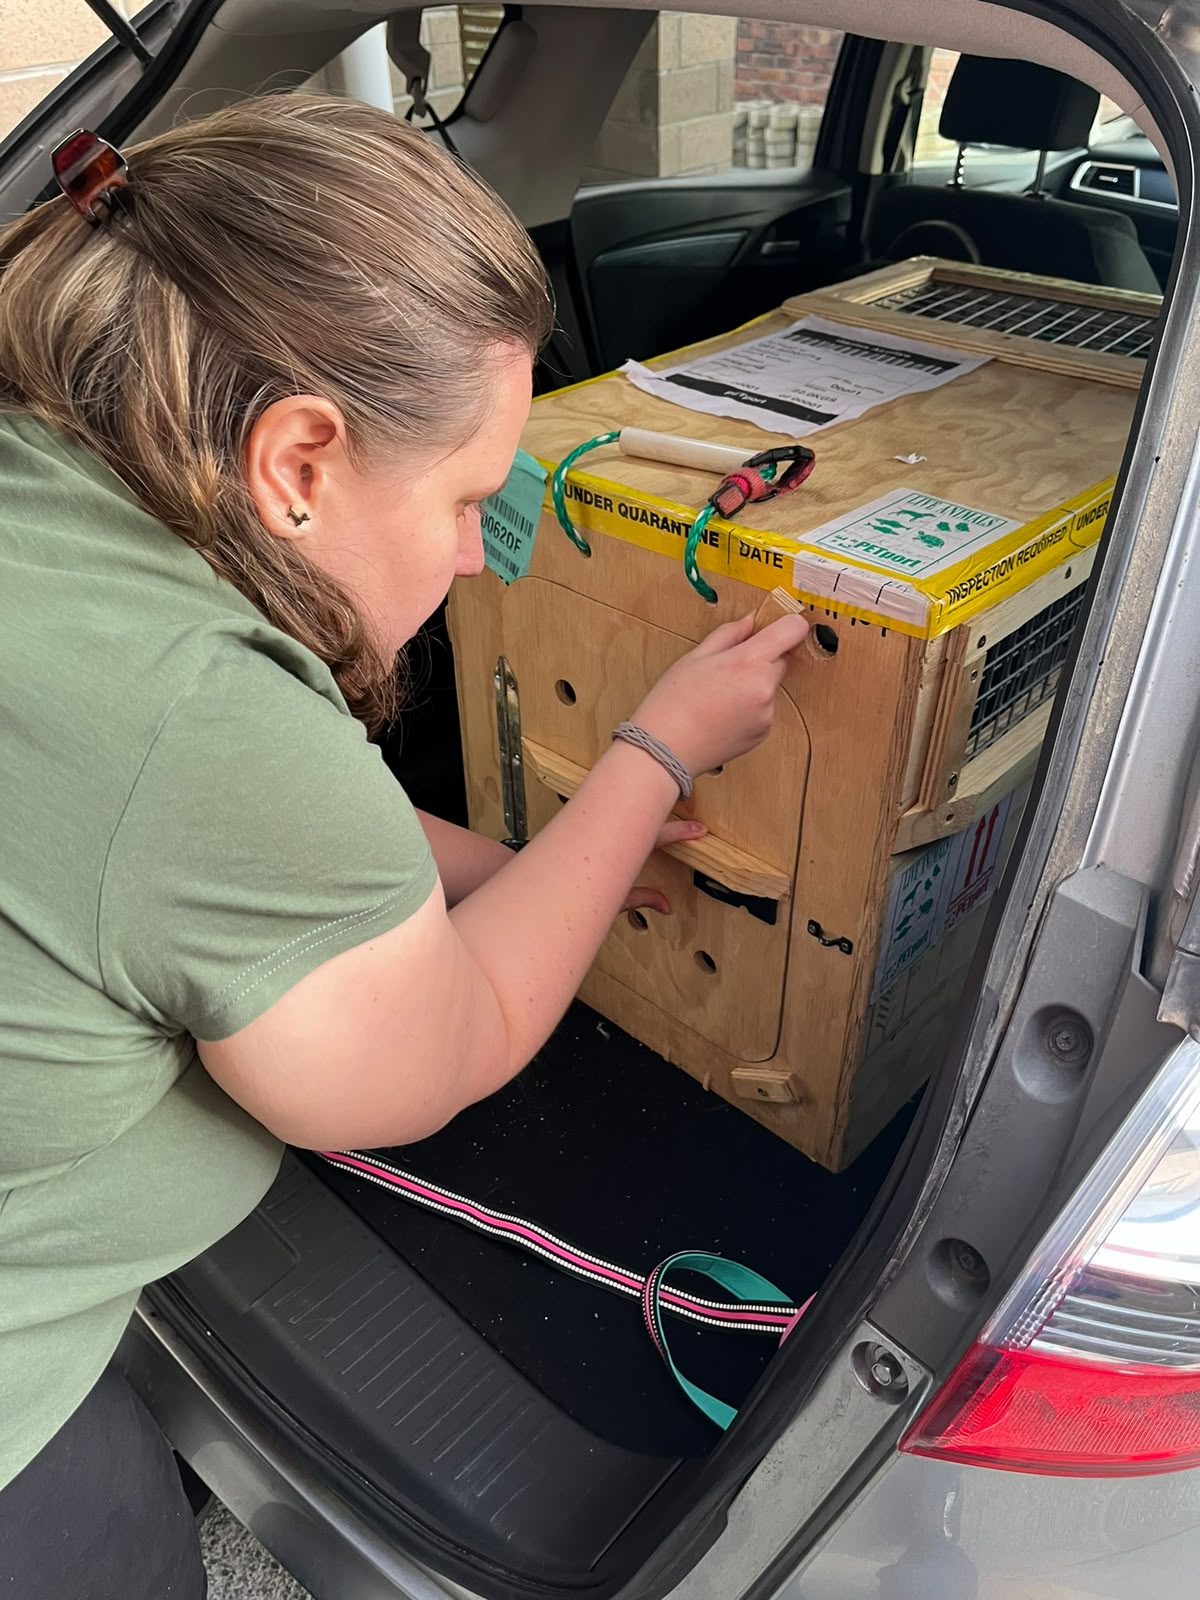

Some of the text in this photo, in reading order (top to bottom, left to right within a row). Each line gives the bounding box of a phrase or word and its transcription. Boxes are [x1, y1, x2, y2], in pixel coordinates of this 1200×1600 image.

[563, 483, 720, 548] UNDER QUARANTNE
[906, 494, 1000, 528] LIVE ANIMALS
[1076, 500, 1110, 531] UNDER
[739, 540, 784, 569] DATE
[853, 541, 921, 567] PETport
[946, 525, 1068, 605] INSPECTION REQUIRED
